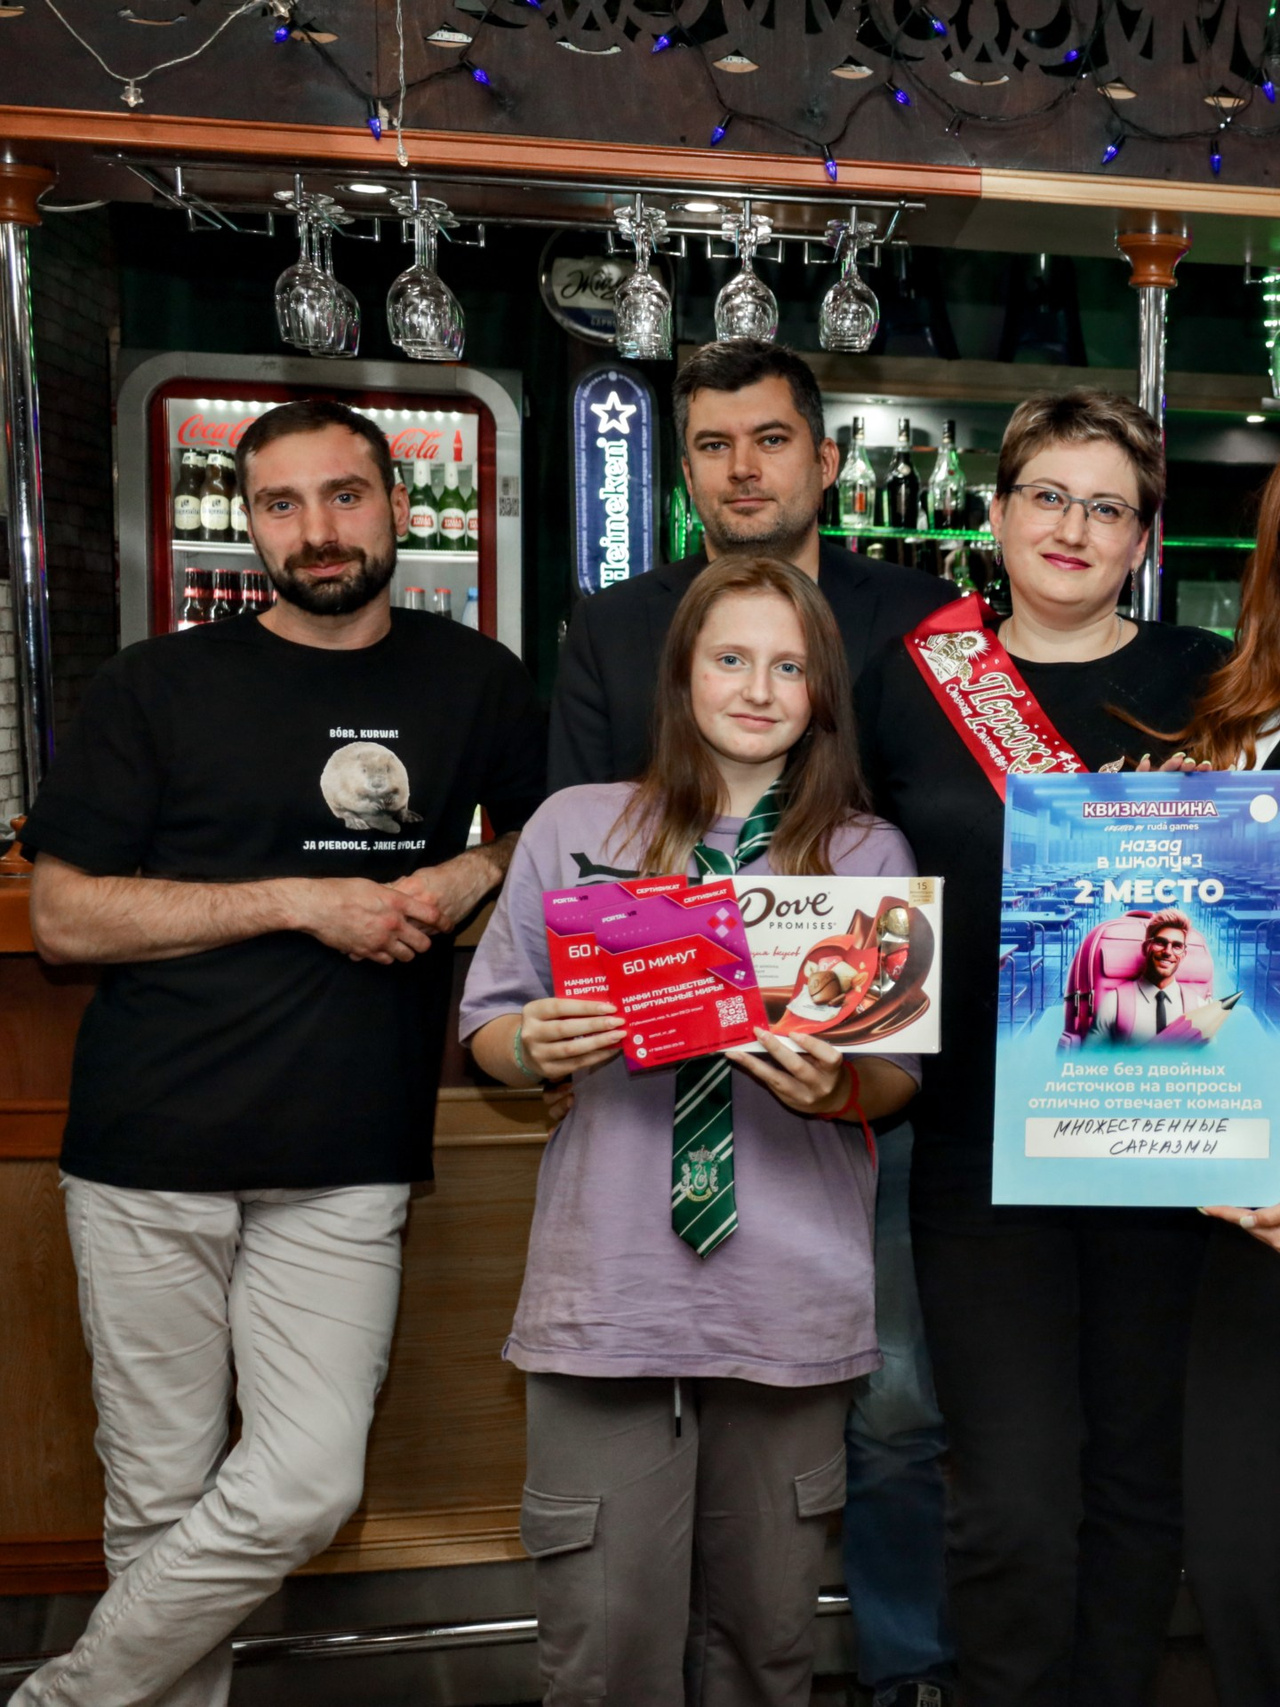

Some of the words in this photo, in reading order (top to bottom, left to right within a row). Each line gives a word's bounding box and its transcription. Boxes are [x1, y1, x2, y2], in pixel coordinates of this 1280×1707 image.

[598, 438, 630, 589] Heineken
[360, 729, 399, 739] KURWA!
[1083, 801, 1218, 818] КВИЗМАШИНА
[1169, 823, 1199, 832] games
[302, 841, 316, 850] JA
[373, 841, 396, 850] JAKIE
[636, 883, 680, 895] СЕРТИФИКАТ
[917, 881, 928, 890] 15
[1074, 880, 1094, 904] 2
[1103, 878, 1225, 904] МЕСТО
[683, 888, 728, 904] СЕРТИФИКАТ
[737, 887, 834, 928] Dove
[601, 912, 627, 923] PORTAL
[769, 922, 833, 930] PROMISES
[568, 944, 591, 958] 60
[622, 959, 646, 975] 60
[648, 949, 698, 969] МИНУТ
[563, 977, 593, 987] НАЧНИ
[565, 988, 572, 996] В
[622, 992, 651, 1005] НАЧНИ
[652, 976, 716, 998] ПУТЕШЕСТВИЕ
[632, 992, 694, 1012] ВИРТУАЛЬНЫЕ
[1061, 1062, 1109, 1077] Даже
[1113, 1062, 1143, 1076] без
[1148, 1062, 1226, 1078] двойных
[1044, 1080, 1135, 1093] листочков
[1140, 1081, 1160, 1093] на
[1165, 1081, 1242, 1095] вопросы
[1028, 1098, 1100, 1110] отлично
[1104, 1098, 1182, 1110] отвечает
[1186, 1098, 1262, 1111] команда
[1053, 1118, 1229, 1138] МНОЖЕСТВЕННЫЕ
[1109, 1139, 1218, 1155] САРКАЗМЫ
